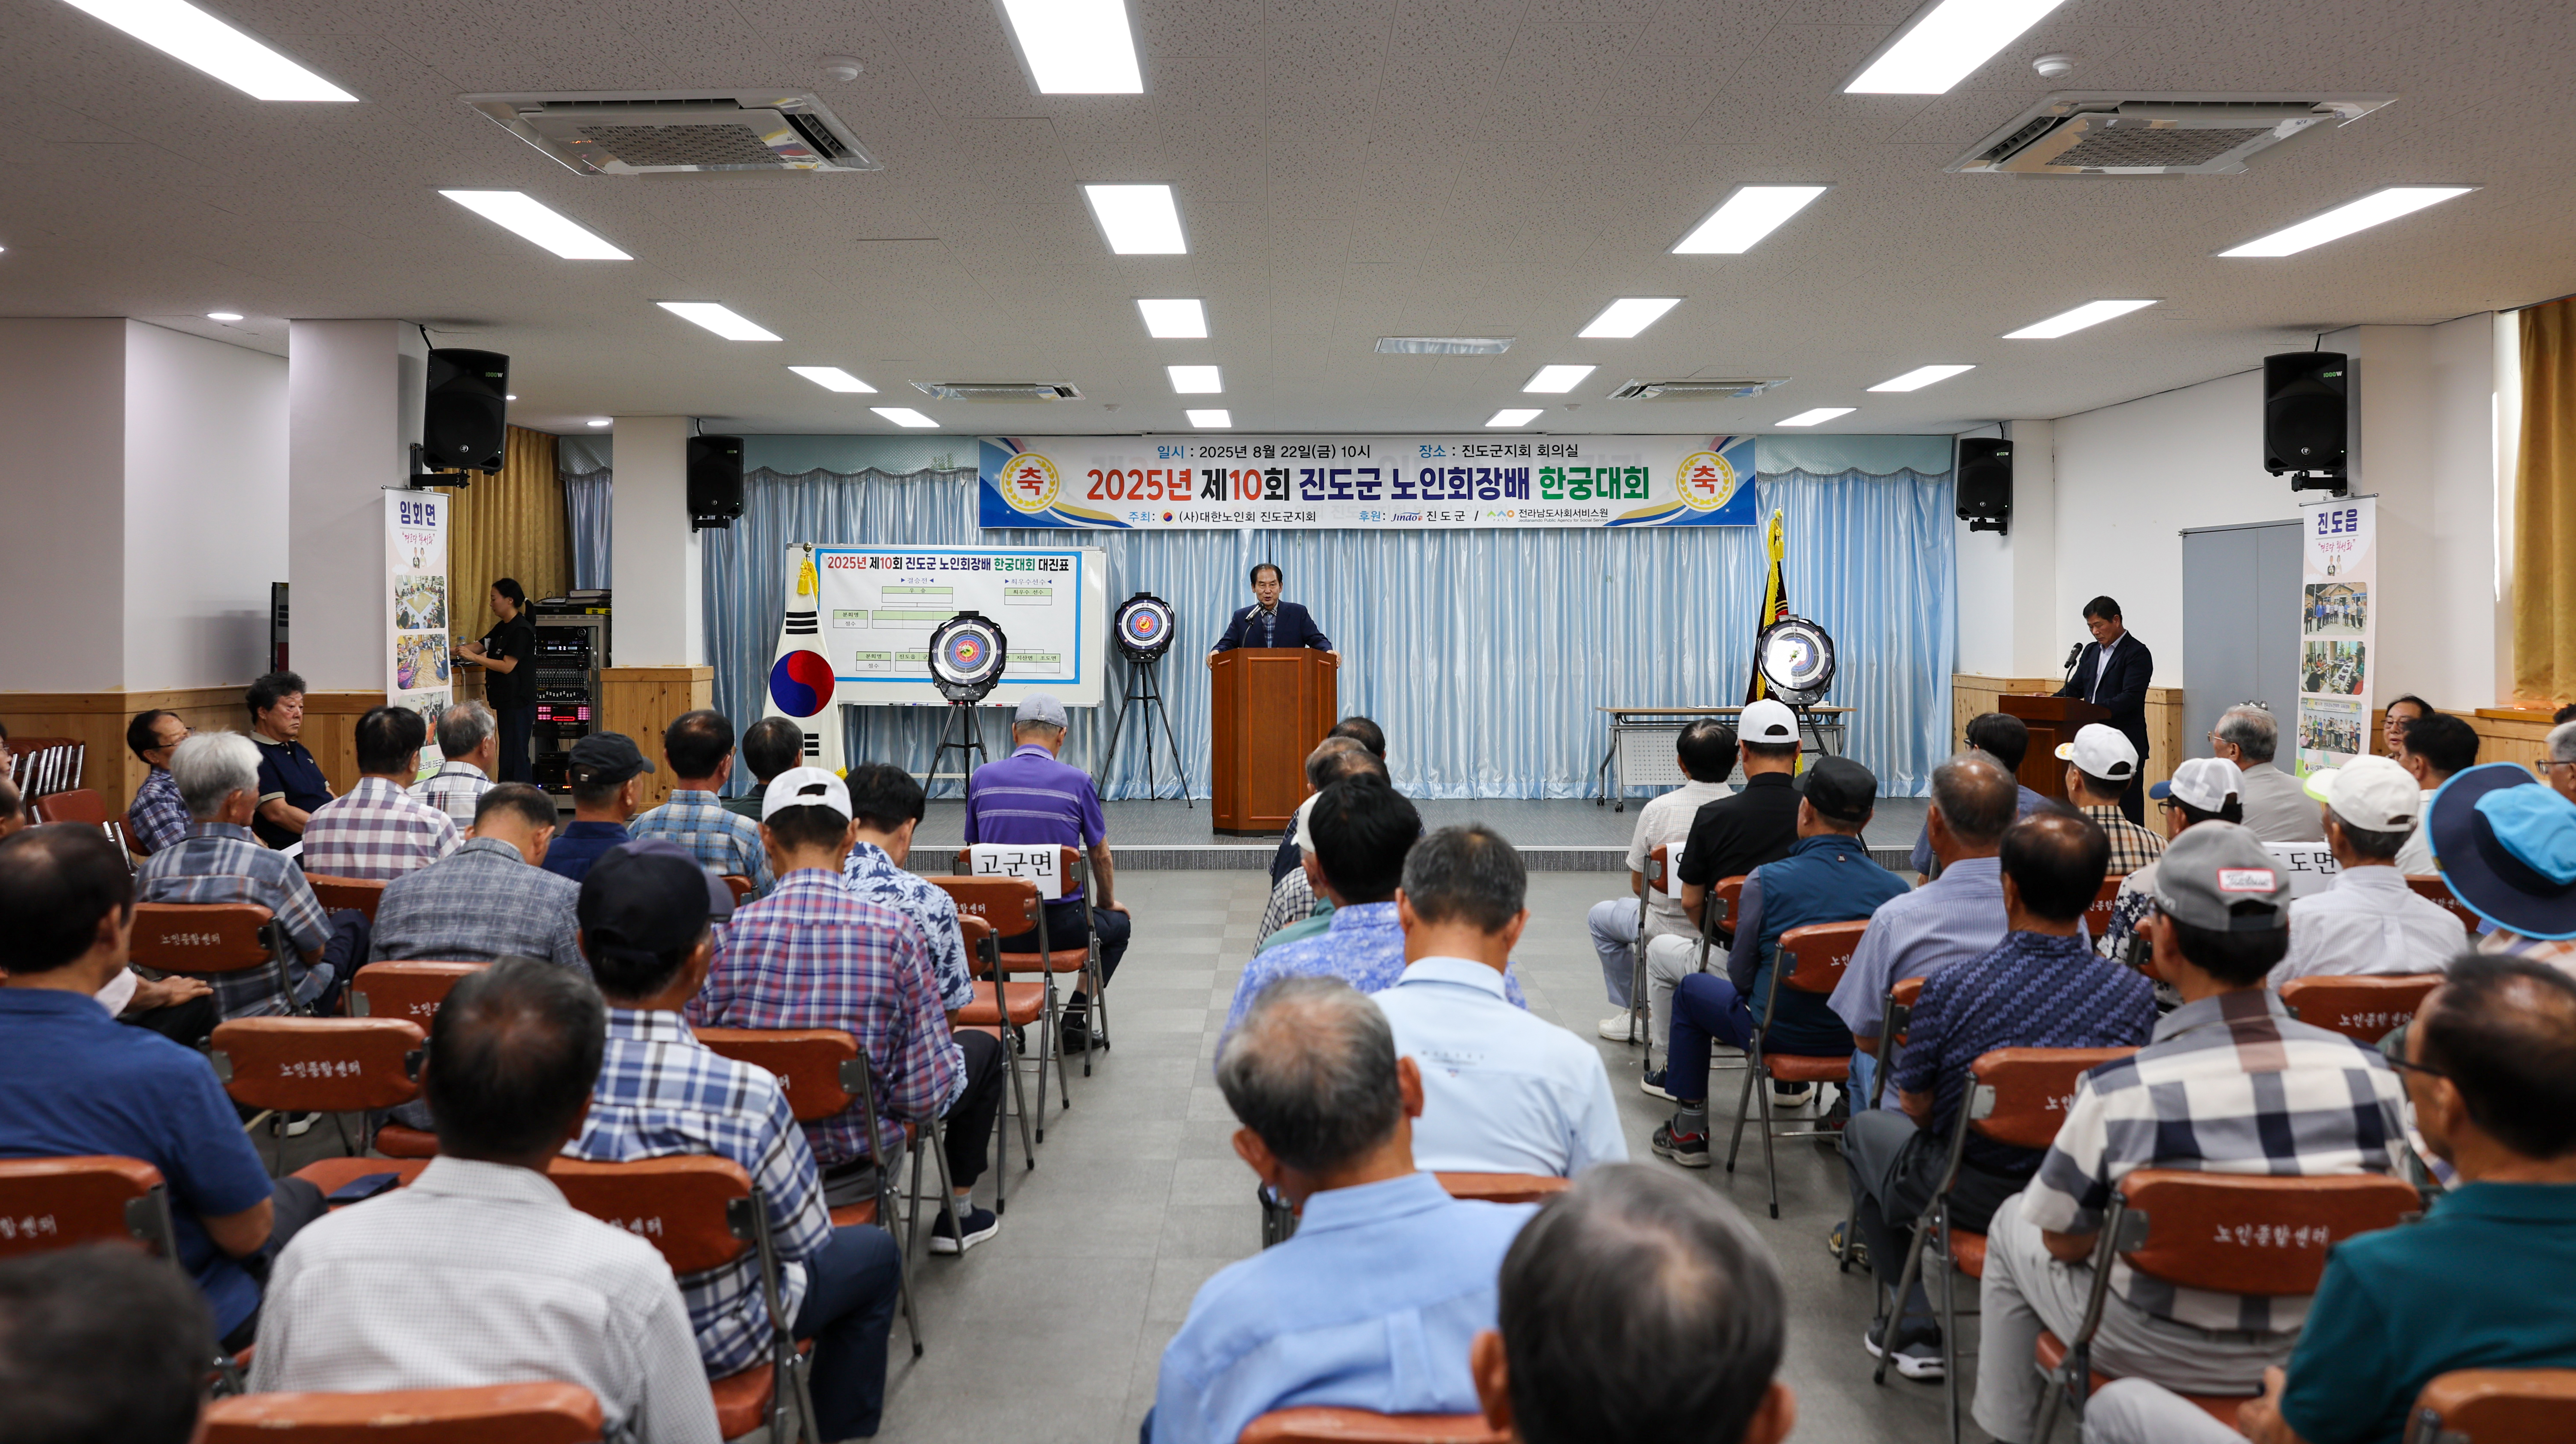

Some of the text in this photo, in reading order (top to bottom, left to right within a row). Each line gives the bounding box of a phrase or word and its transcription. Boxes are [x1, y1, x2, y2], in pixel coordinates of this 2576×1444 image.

[1157, 445, 1184, 459] 일시
[1199, 445, 1247, 459] 2025년
[1253, 444, 1275, 459] 8월
[1281, 444, 1336, 459] 22일(금)
[1341, 444, 1370, 458] 10시
[1419, 444, 1446, 458] 장소
[1461, 443, 1531, 458] 진도군지회
[1537, 443, 1578, 458] 회의실
[1018, 467, 1043, 495] 축
[1087, 466, 1649, 501] 2025년 제10회 진도군 노인회장배 한궁대회
[1692, 466, 1718, 494] 축
[400, 501, 435, 526] 임회면
[1128, 511, 1316, 523] 주최: (사)대한노인회 진도군지회
[1358, 510, 1385, 522] 후원:
[1519, 508, 1608, 518] 전라남도사회서비스원
[2318, 508, 2357, 535] 진도읍
[827, 556, 1069, 572] 2025년 제10회 진도군 노인회장배 한궁대회 대진표
[978, 851, 1053, 877] 고군면
